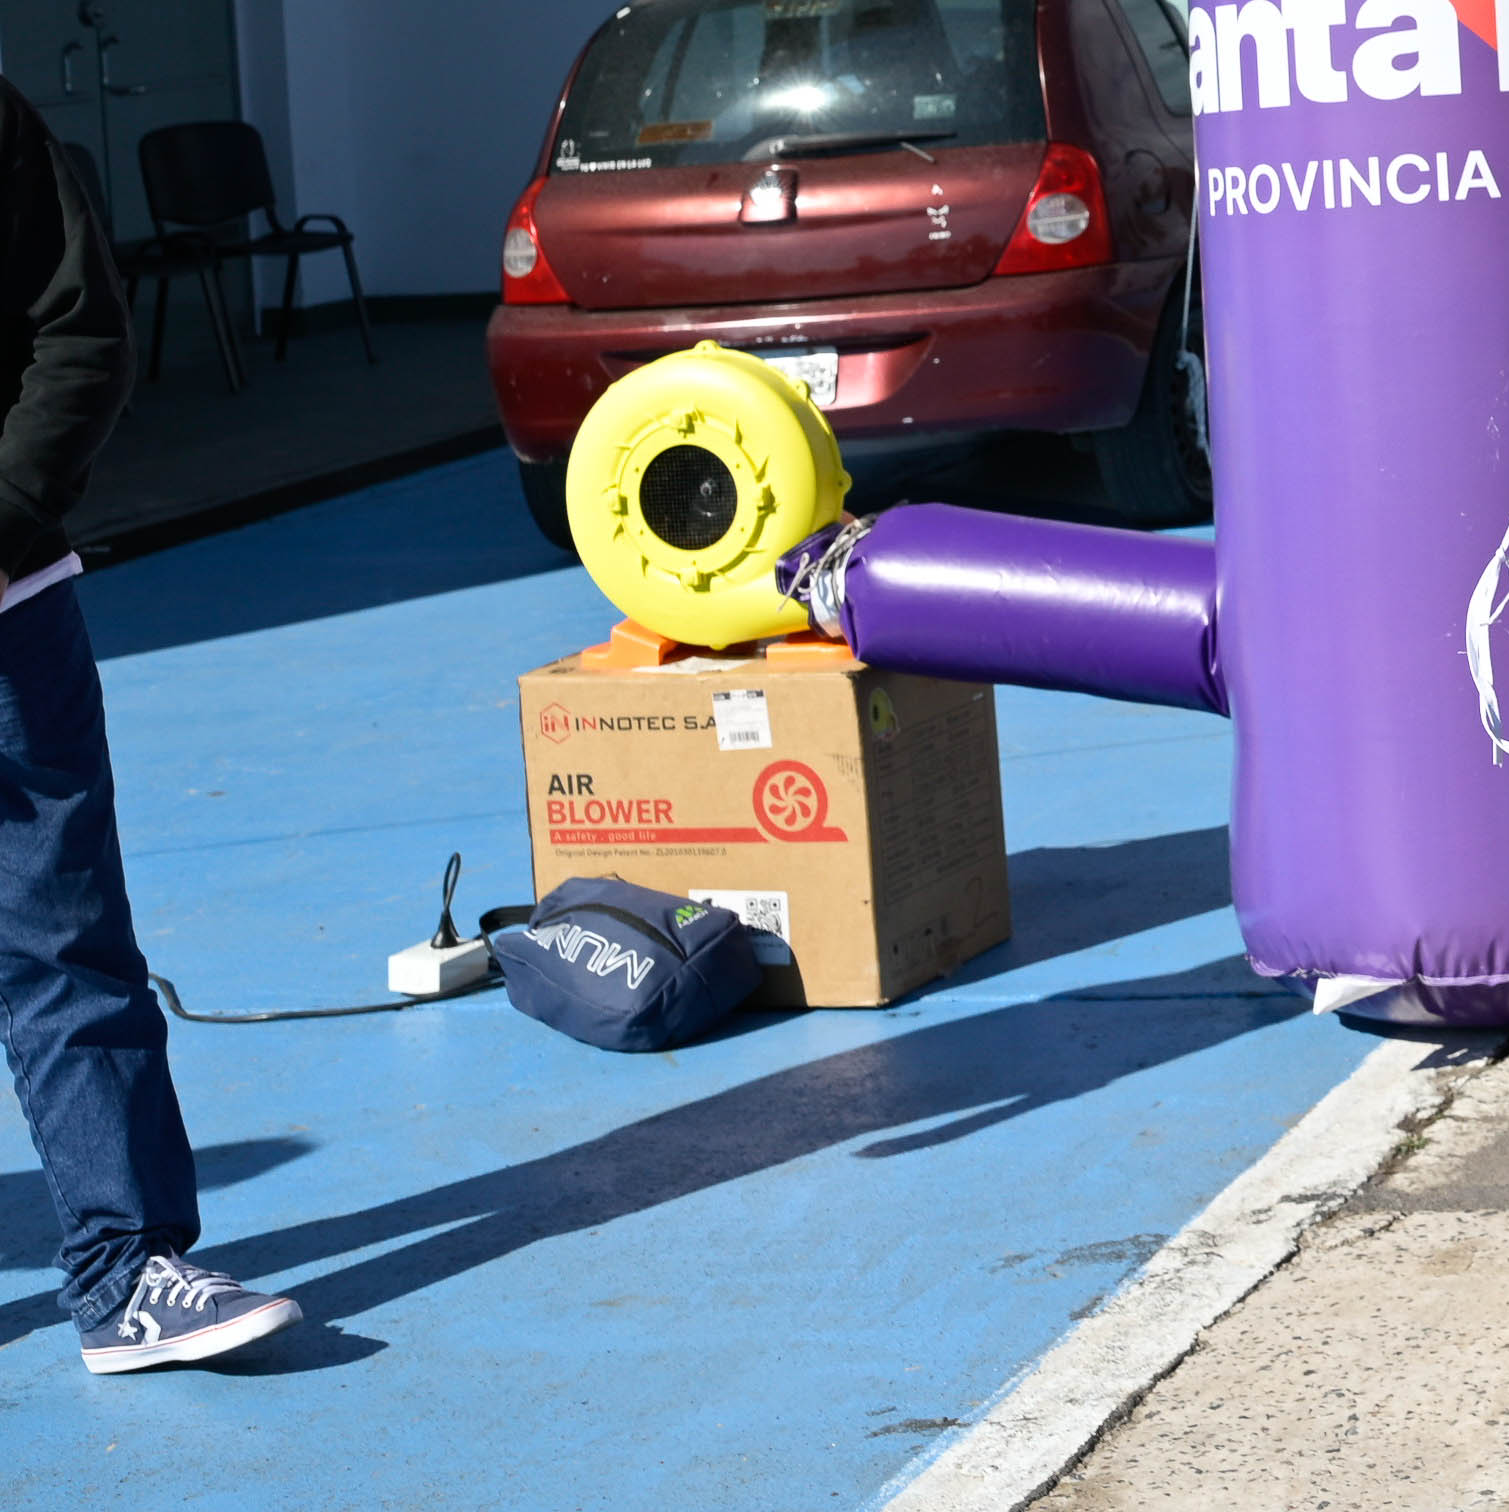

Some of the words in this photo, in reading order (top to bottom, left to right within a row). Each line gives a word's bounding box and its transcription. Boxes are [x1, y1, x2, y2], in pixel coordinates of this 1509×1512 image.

[1209, 150, 1502, 217] PROVINCIA
[576, 716, 676, 731] INNOTEC
[548, 774, 594, 795] AIR
[547, 799, 674, 824] BLOWER
[554, 832, 562, 841] A
[566, 831, 597, 843] safety
[608, 831, 636, 843] good
[639, 830, 657, 841] life
